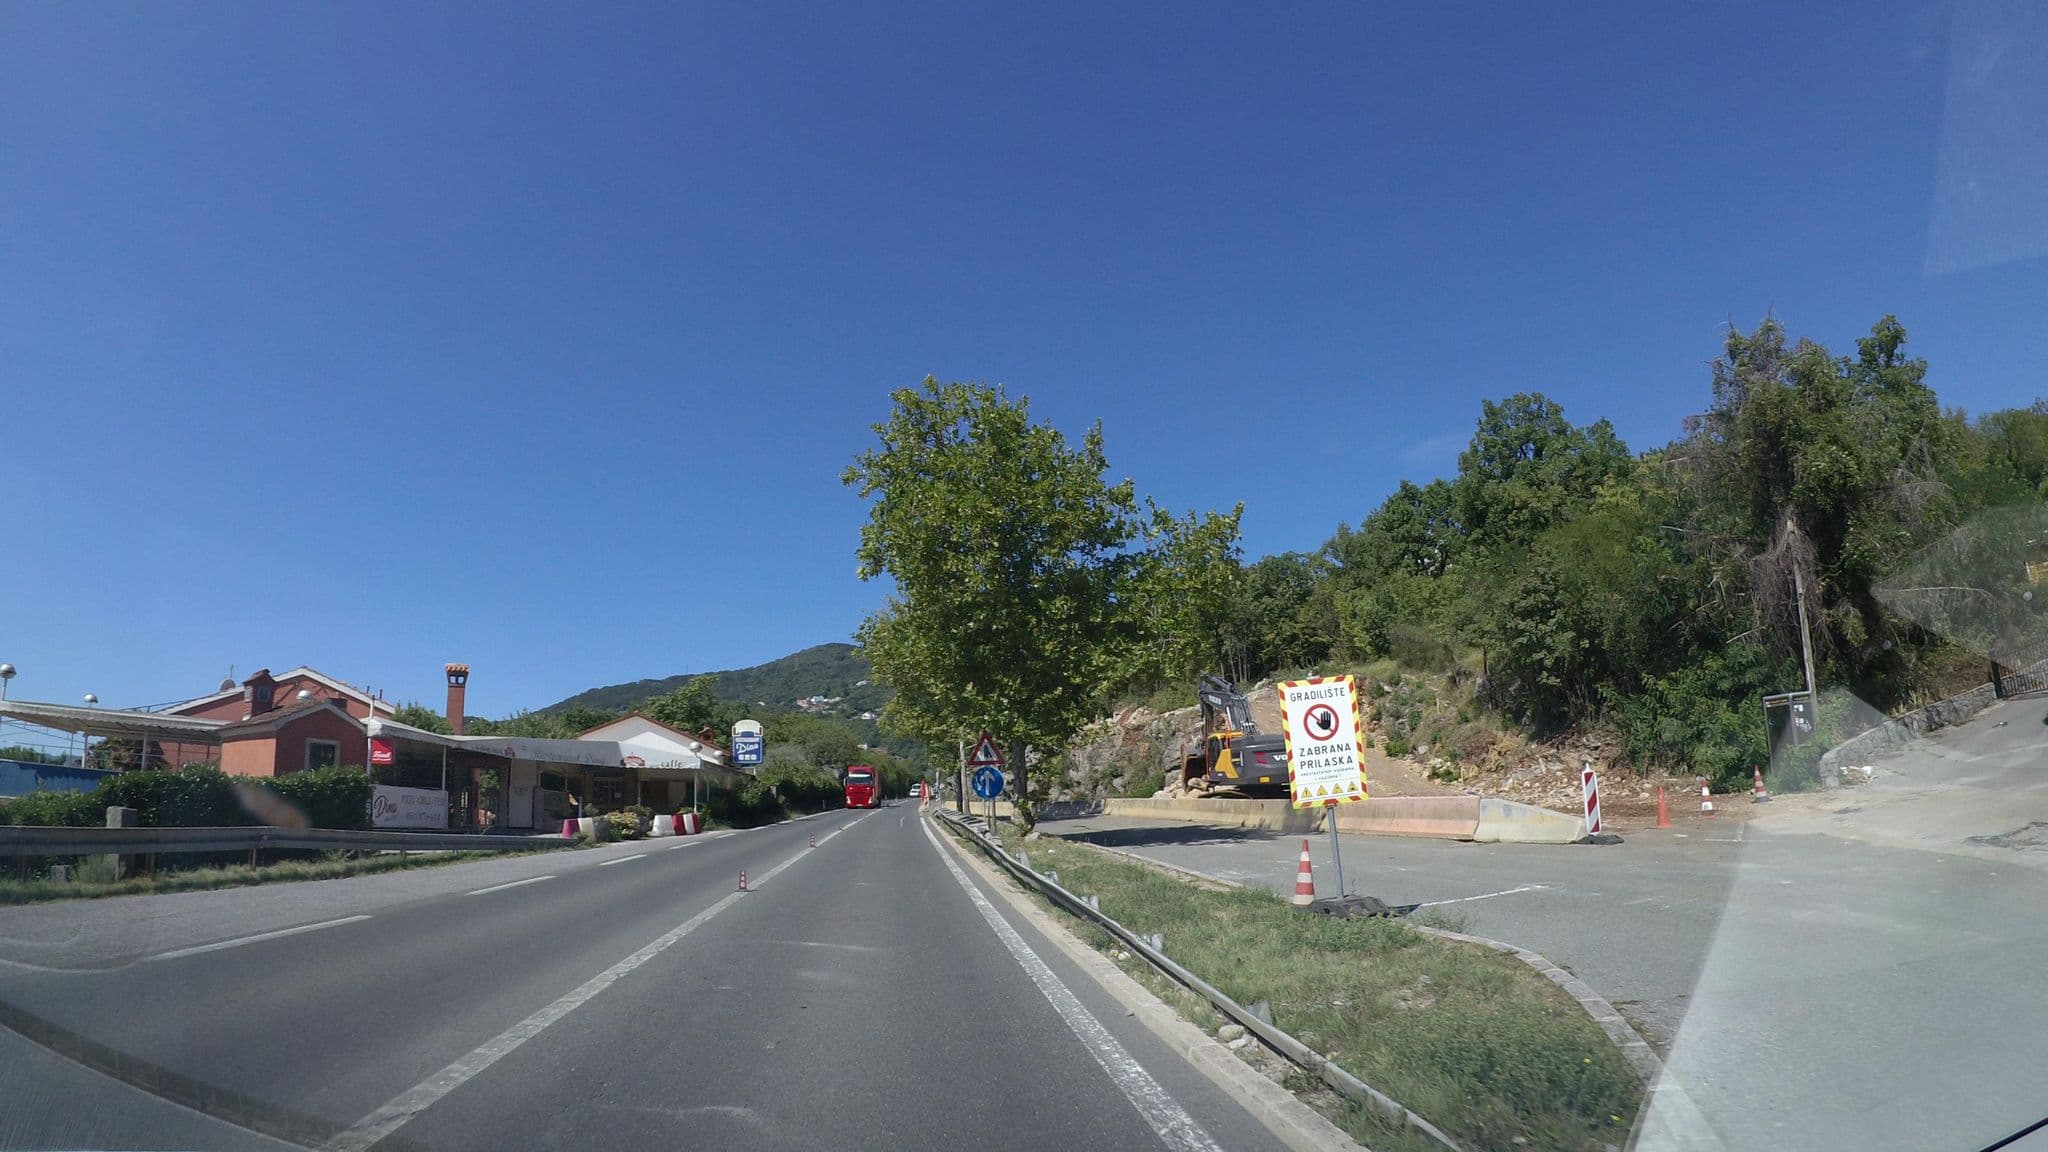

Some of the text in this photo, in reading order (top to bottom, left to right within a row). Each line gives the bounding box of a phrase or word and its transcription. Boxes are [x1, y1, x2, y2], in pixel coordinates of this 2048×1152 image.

[1290, 686, 1345, 702] GRADILIŠTE
[1299, 742, 1352, 757] ZABRANA
[1299, 755, 1353, 770] PRILASKA
